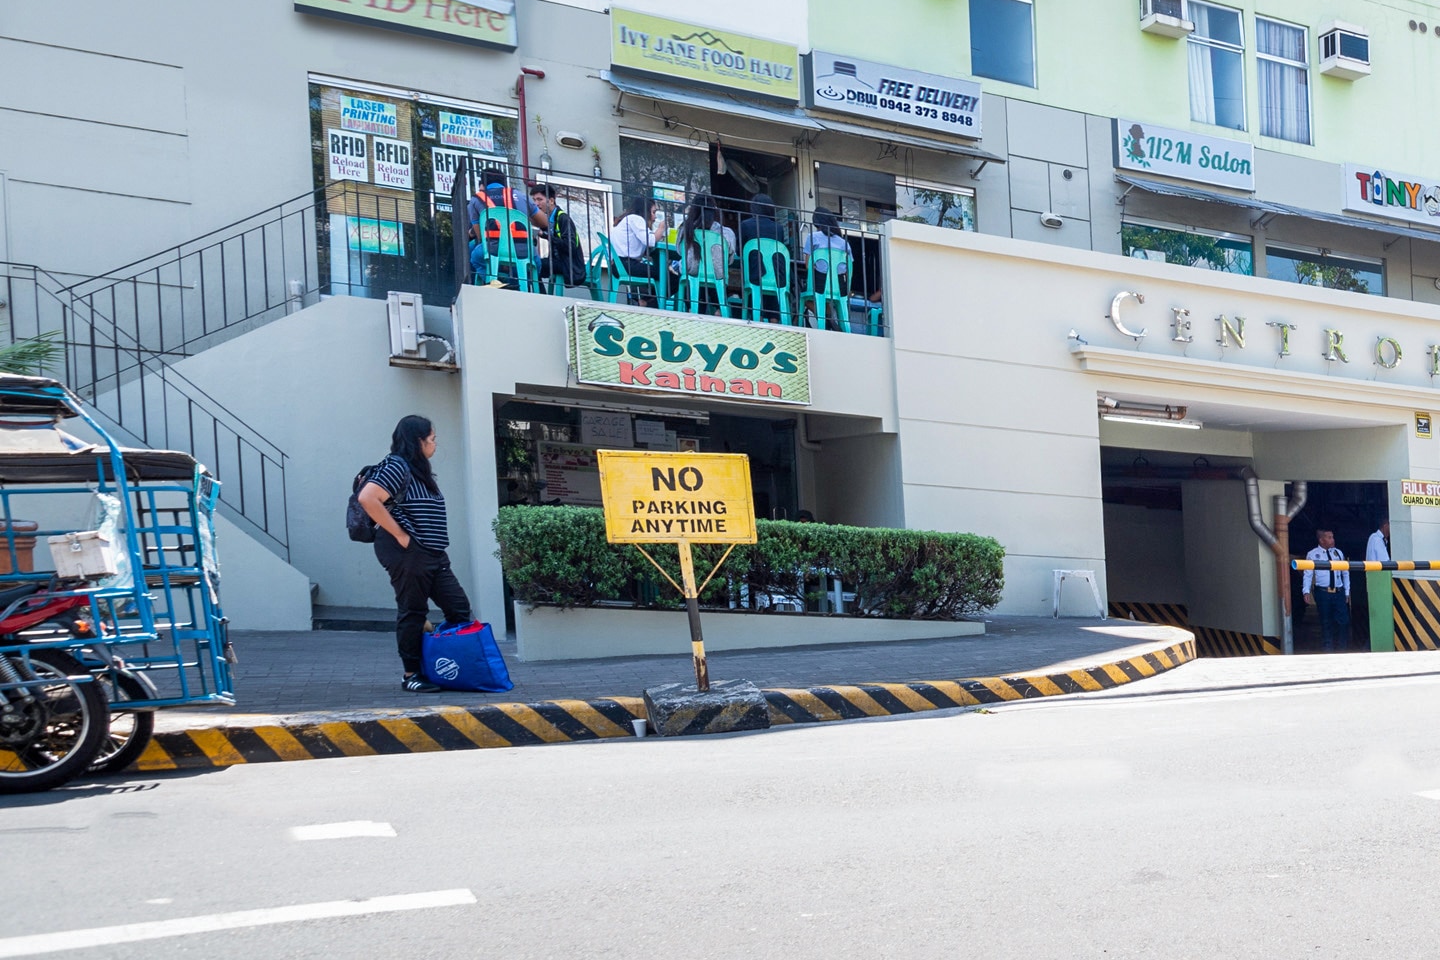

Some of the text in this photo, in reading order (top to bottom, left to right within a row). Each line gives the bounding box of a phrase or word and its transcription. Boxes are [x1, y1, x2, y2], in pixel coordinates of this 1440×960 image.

[619, 24, 793, 82] IVY JANE FOOD HAUZ
[847, 89, 878, 107] DBW
[878, 78, 980, 113] FREE DELIVERY
[351, 98, 385, 113] LASER
[880, 97, 912, 114] 0942
[915, 105, 938, 120] 373
[941, 112, 974, 127] 8948
[342, 107, 396, 126] PRINTING
[450, 115, 483, 128] LASER
[342, 117, 396, 137] LAMINATION
[441, 123, 493, 140] PRINTING
[330, 133, 366, 159] RFID
[375, 141, 411, 167] RFID
[332, 155, 366, 170] Reload
[1198, 145, 1252, 176] Salon
[337, 165, 361, 178] Here
[377, 163, 410, 177] Reload
[382, 172, 406, 186] Here
[1355, 170, 1424, 210] TINY
[350, 225, 400, 243] XEROX
[592, 324, 799, 375] Sebyo's
[617, 360, 782, 399] Kainan
[583, 415, 625, 427] GARAGE
[651, 467, 703, 492] NO
[1403, 482, 1425, 495] FULL
[632, 500, 727, 515] PARKING
[1403, 495, 1424, 505] GUARD
[1425, 497, 1434, 506] ON
[631, 519, 727, 533] ANYTIME
